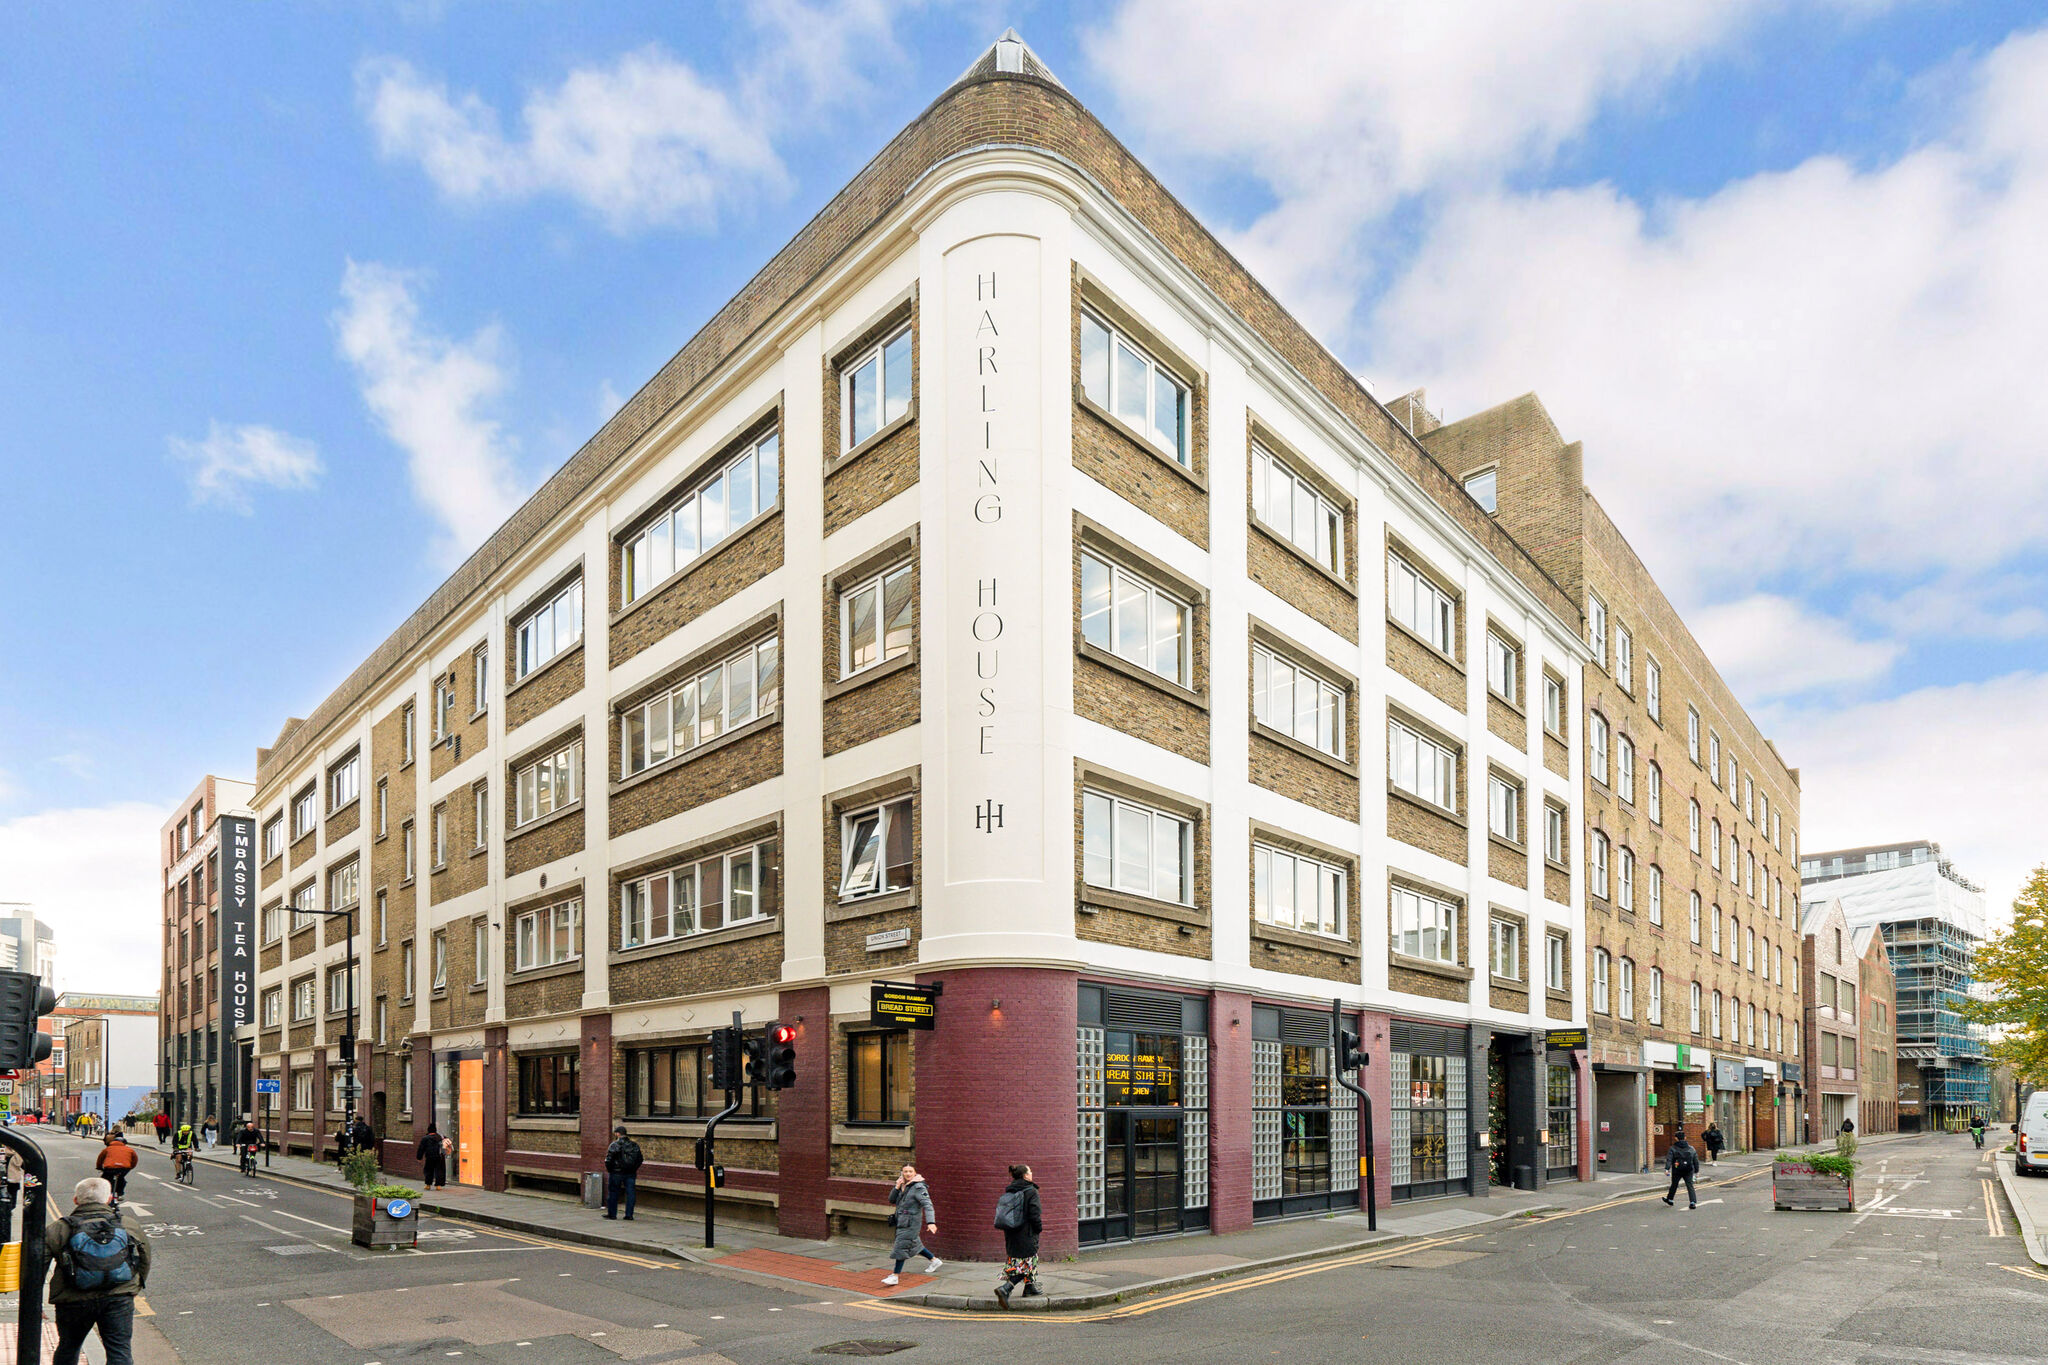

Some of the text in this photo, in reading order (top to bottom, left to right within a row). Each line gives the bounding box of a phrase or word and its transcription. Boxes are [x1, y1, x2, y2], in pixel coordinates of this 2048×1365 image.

[972, 271, 1003, 754] HARLING HOUSE
[234, 823, 249, 1028] EMBASSY TEA HOUSE
[880, 1003, 930, 1013] BREAD STREET
